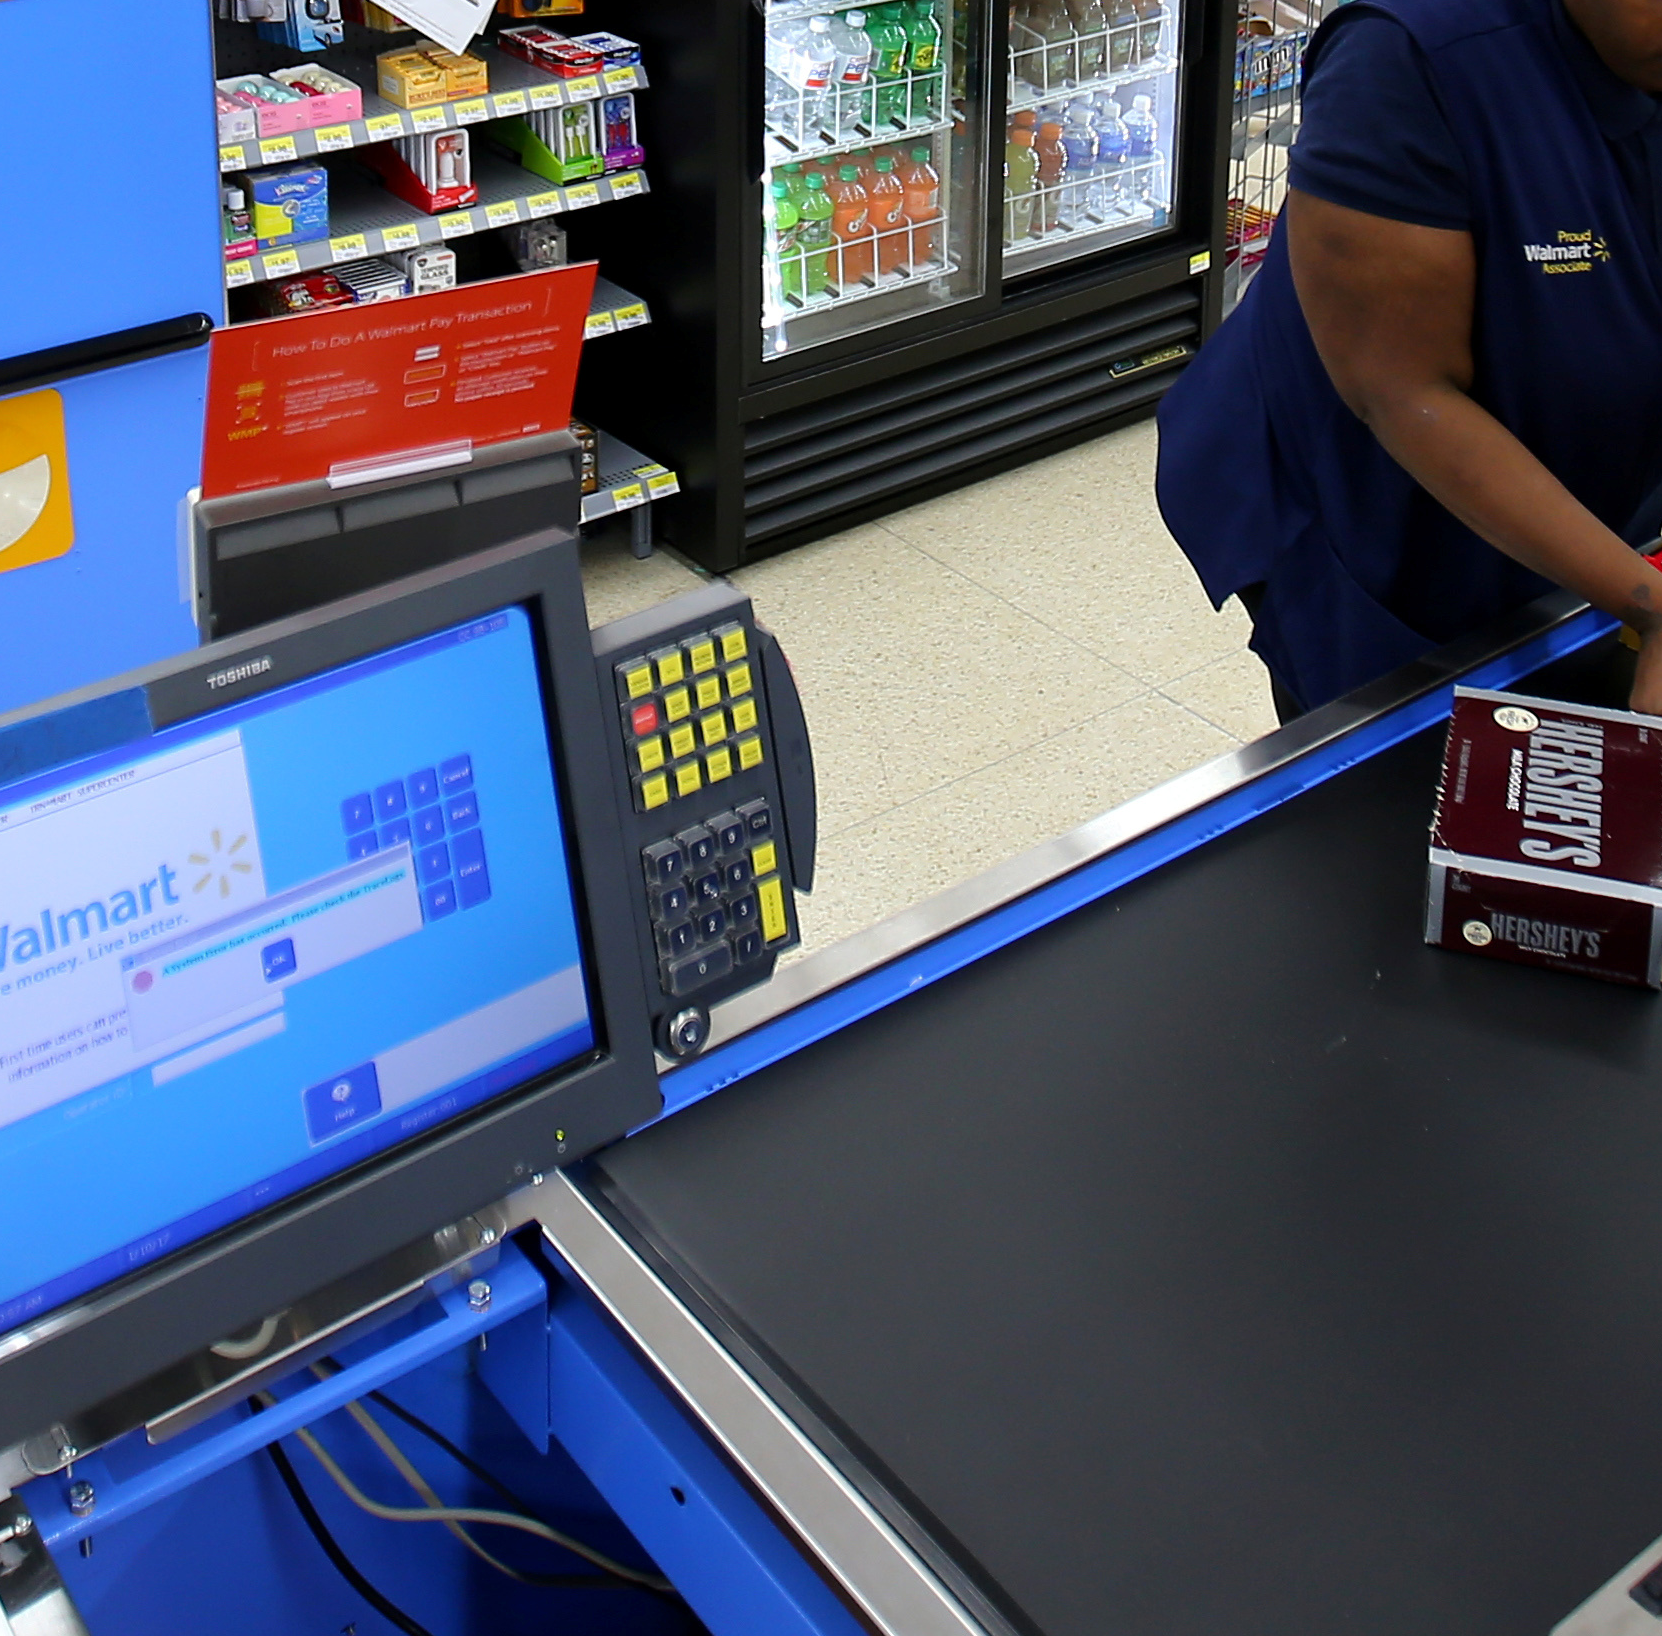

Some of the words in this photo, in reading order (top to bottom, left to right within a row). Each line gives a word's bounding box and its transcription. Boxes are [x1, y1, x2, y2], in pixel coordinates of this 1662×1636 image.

[1524, 242, 1592, 262] Walmart
[1557, 230, 1592, 244] Proud
[1542, 261, 1593, 274] Associate
[272, 345, 306, 358] How
[309, 340, 327, 352] To
[329, 336, 352, 349] Do
[354, 332, 365, 342] A
[367, 321, 426, 342] Walmart
[428, 316, 453, 330] Pay
[456, 299, 532, 323] Transaction
[206, 656, 273, 690] TOSHIBA
[1512, 748, 1524, 767] MILK
[1506, 766, 1523, 813] CHOCOLATE
[1519, 718, 1605, 868] HERSHEY'S
[15, 952, 84, 994] money.
[86, 934, 125, 962] Live
[128, 908, 189, 947] better.
[1491, 912, 1600, 958] HERSHEY'S
